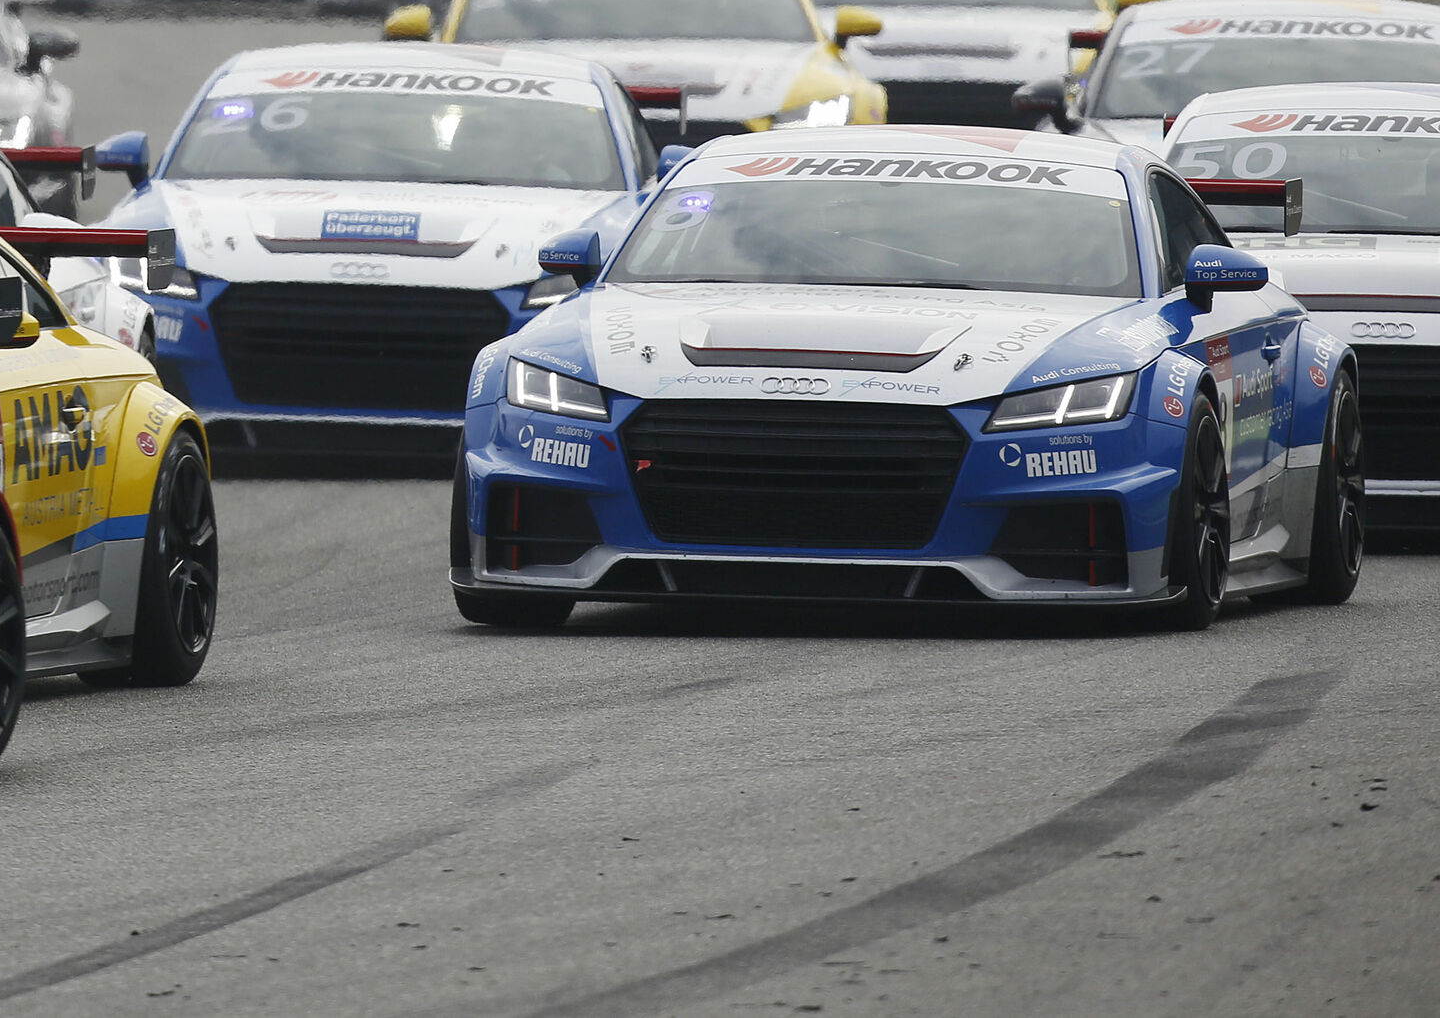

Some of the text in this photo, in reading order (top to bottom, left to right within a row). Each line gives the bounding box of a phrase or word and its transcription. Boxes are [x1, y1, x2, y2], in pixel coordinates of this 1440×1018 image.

[1121, 42, 1216, 78] 27
[1175, 142, 1288, 179] 50
[549, 252, 580, 262] Service
[1194, 259, 1223, 267] Audi
[1195, 269, 1258, 281] Top Service
[1032, 360, 1121, 384] Audi Consulting
[1049, 434, 1093, 446] solutions by
[530, 437, 592, 469] REHAU
[1026, 449, 1098, 478] REHAU
